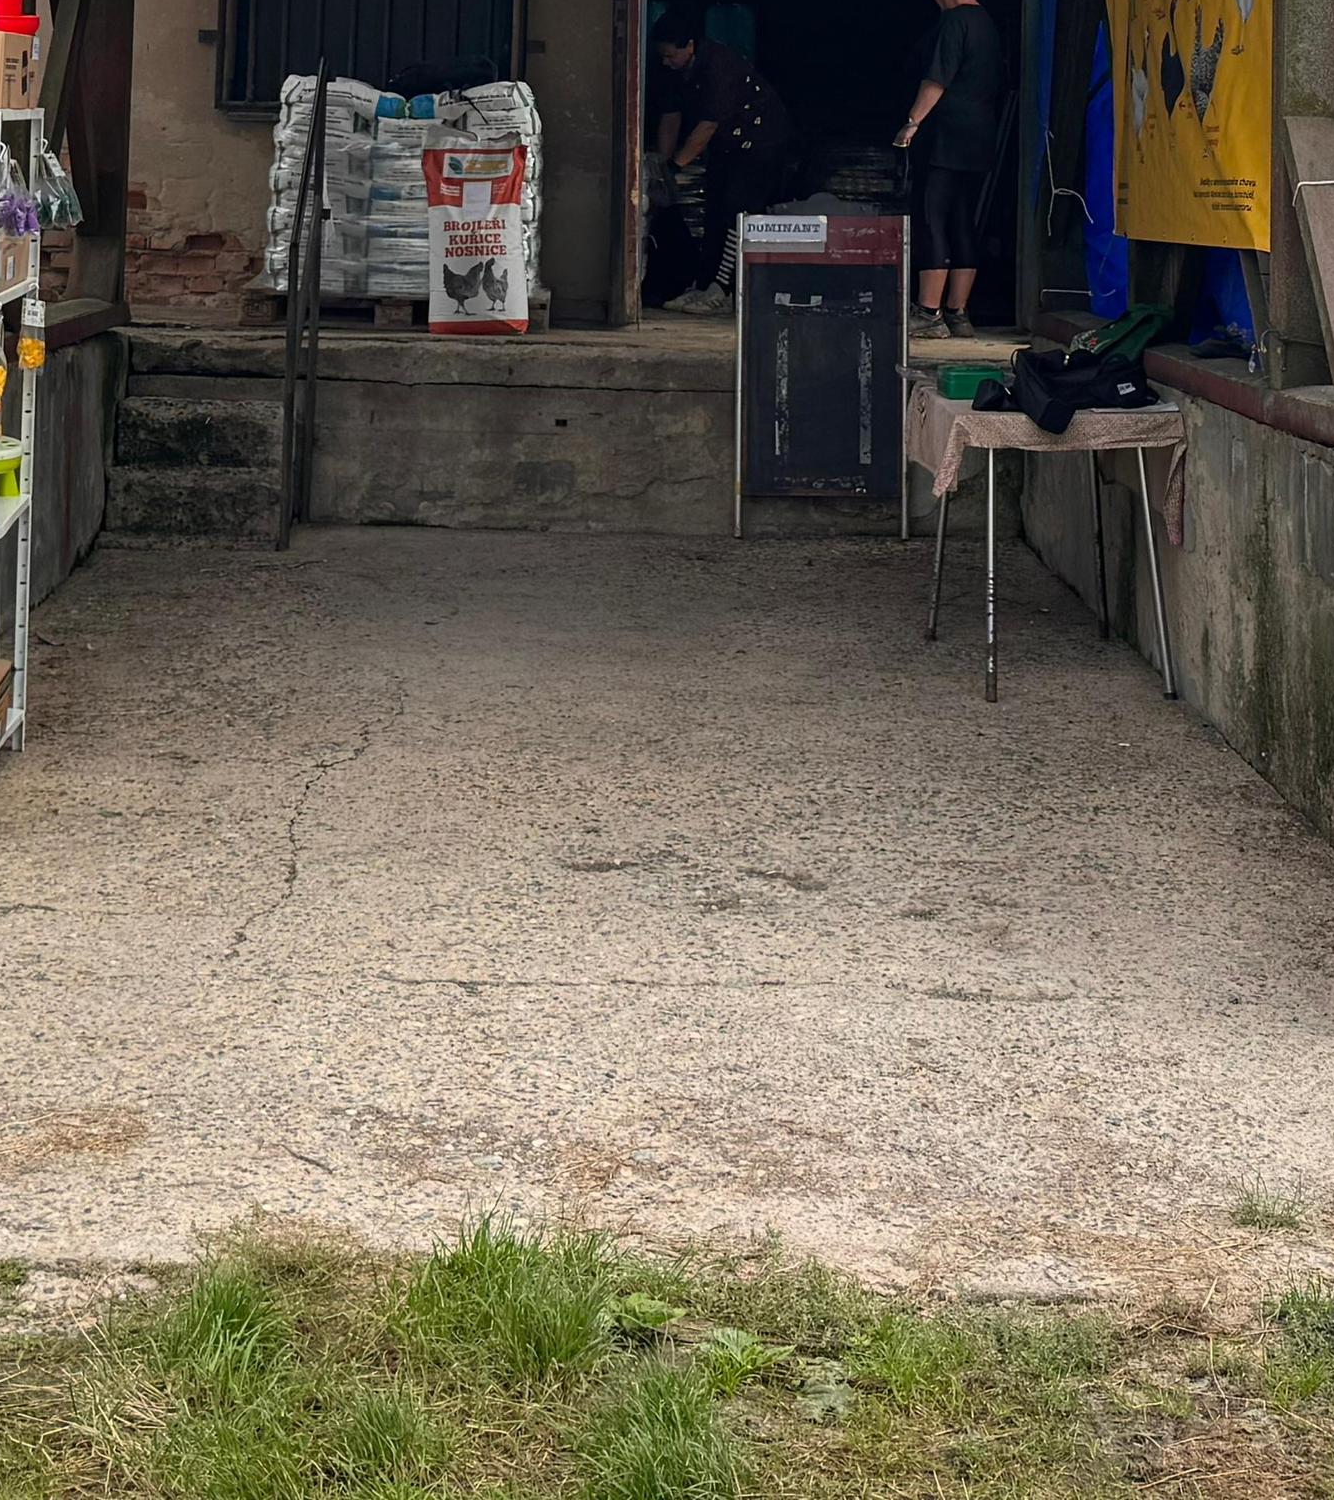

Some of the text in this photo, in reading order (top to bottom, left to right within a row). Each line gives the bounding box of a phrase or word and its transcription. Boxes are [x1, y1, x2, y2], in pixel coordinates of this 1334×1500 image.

[443, 217, 507, 232] BROJLEŘI
[747, 223, 821, 233] DOMINANT
[449, 232, 501, 245] KUŘICE
[445, 245, 507, 258] NOSNICE
